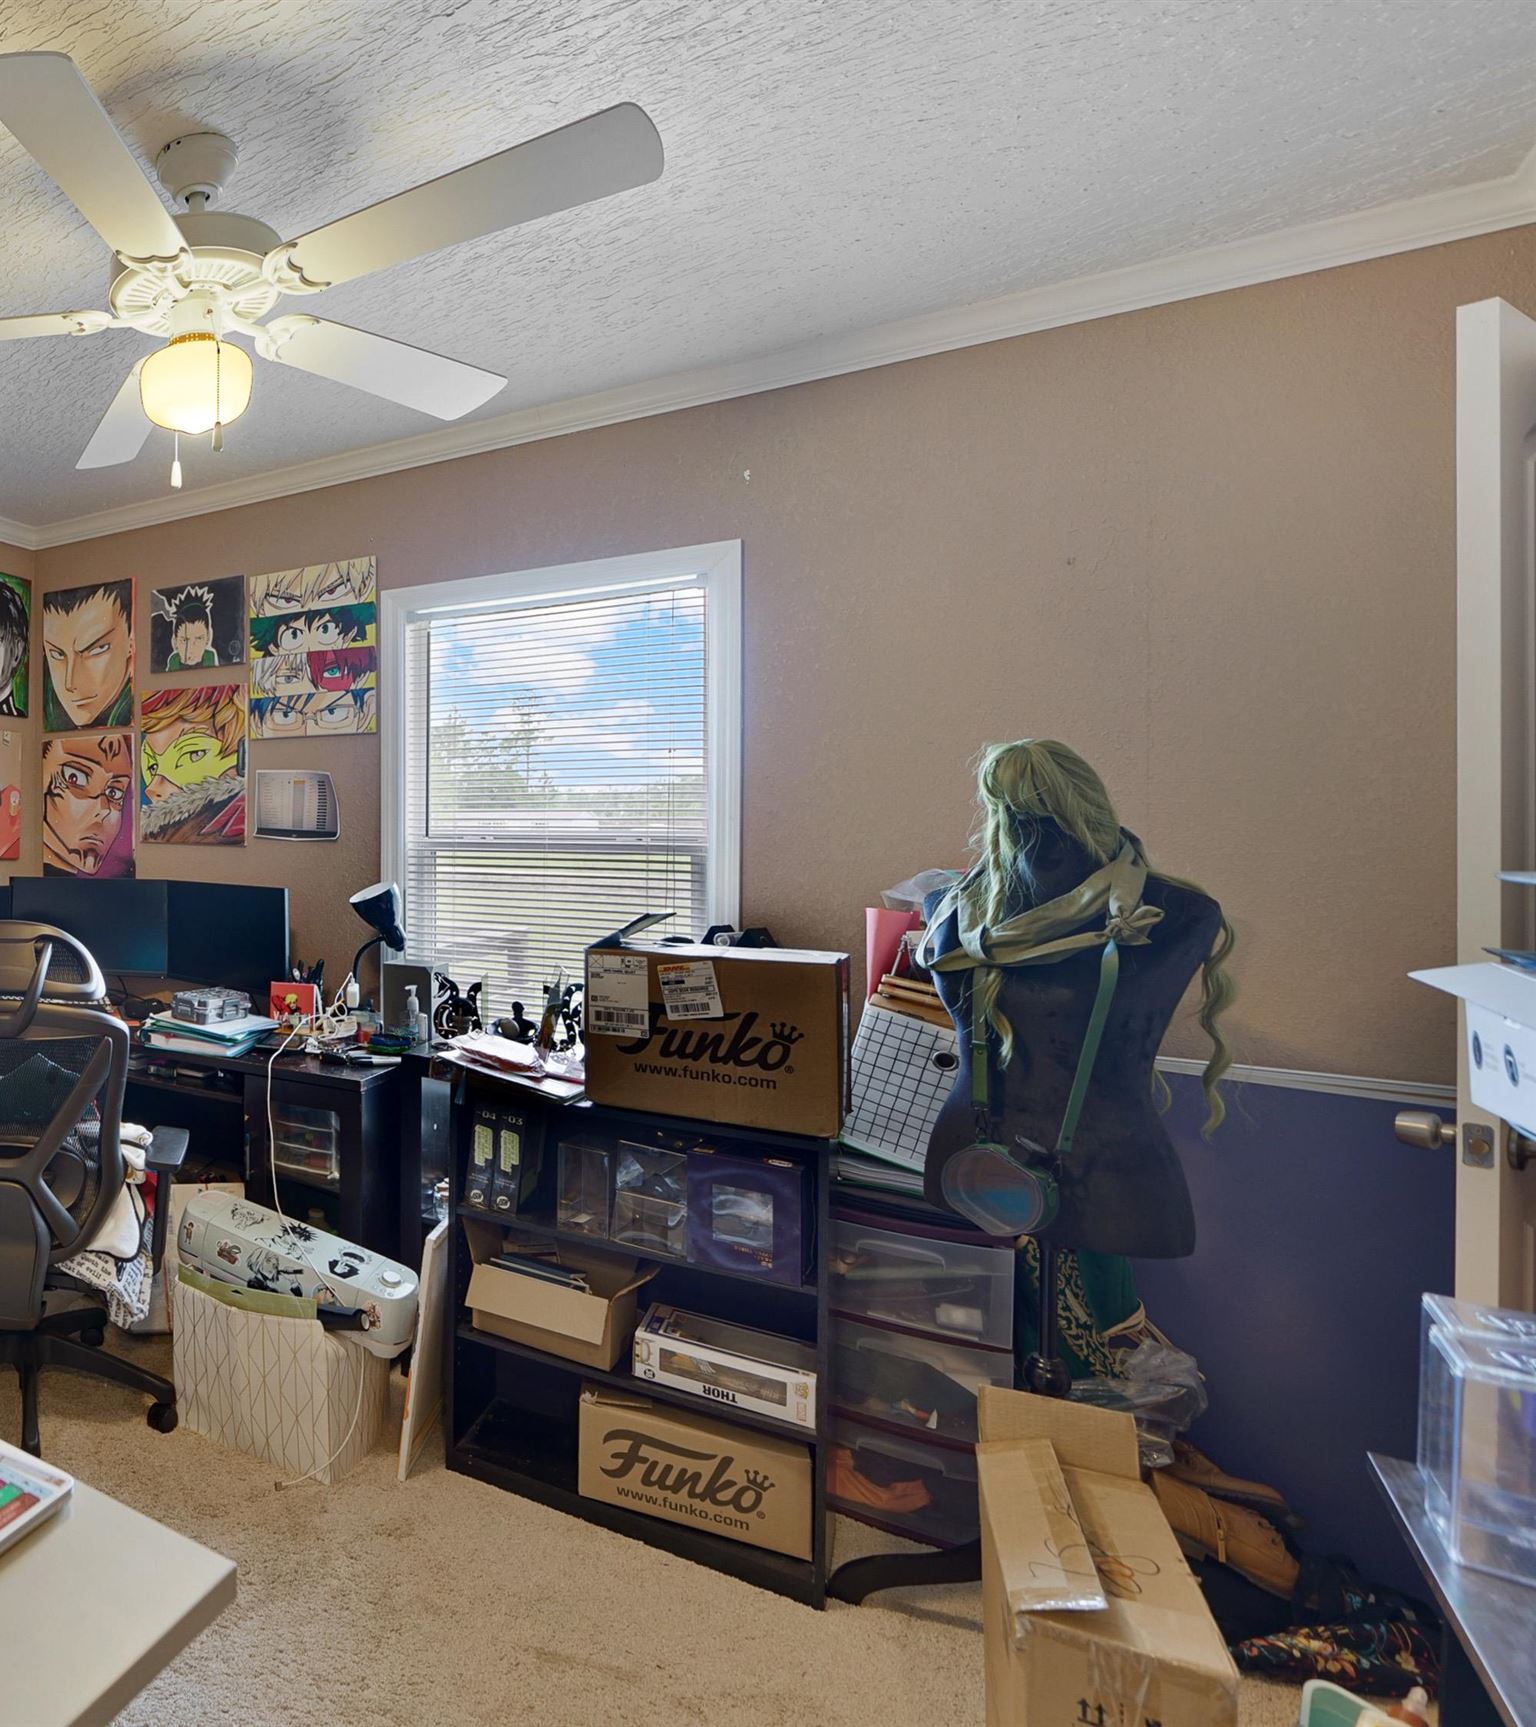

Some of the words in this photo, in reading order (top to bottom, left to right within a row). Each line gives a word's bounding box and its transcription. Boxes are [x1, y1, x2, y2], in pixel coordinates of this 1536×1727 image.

[634, 1062, 777, 1090] www.funko.com
[703, 1384, 738, 1404] THOR
[599, 1428, 764, 1514] Funko
[616, 1485, 751, 1531] www.funko.com
